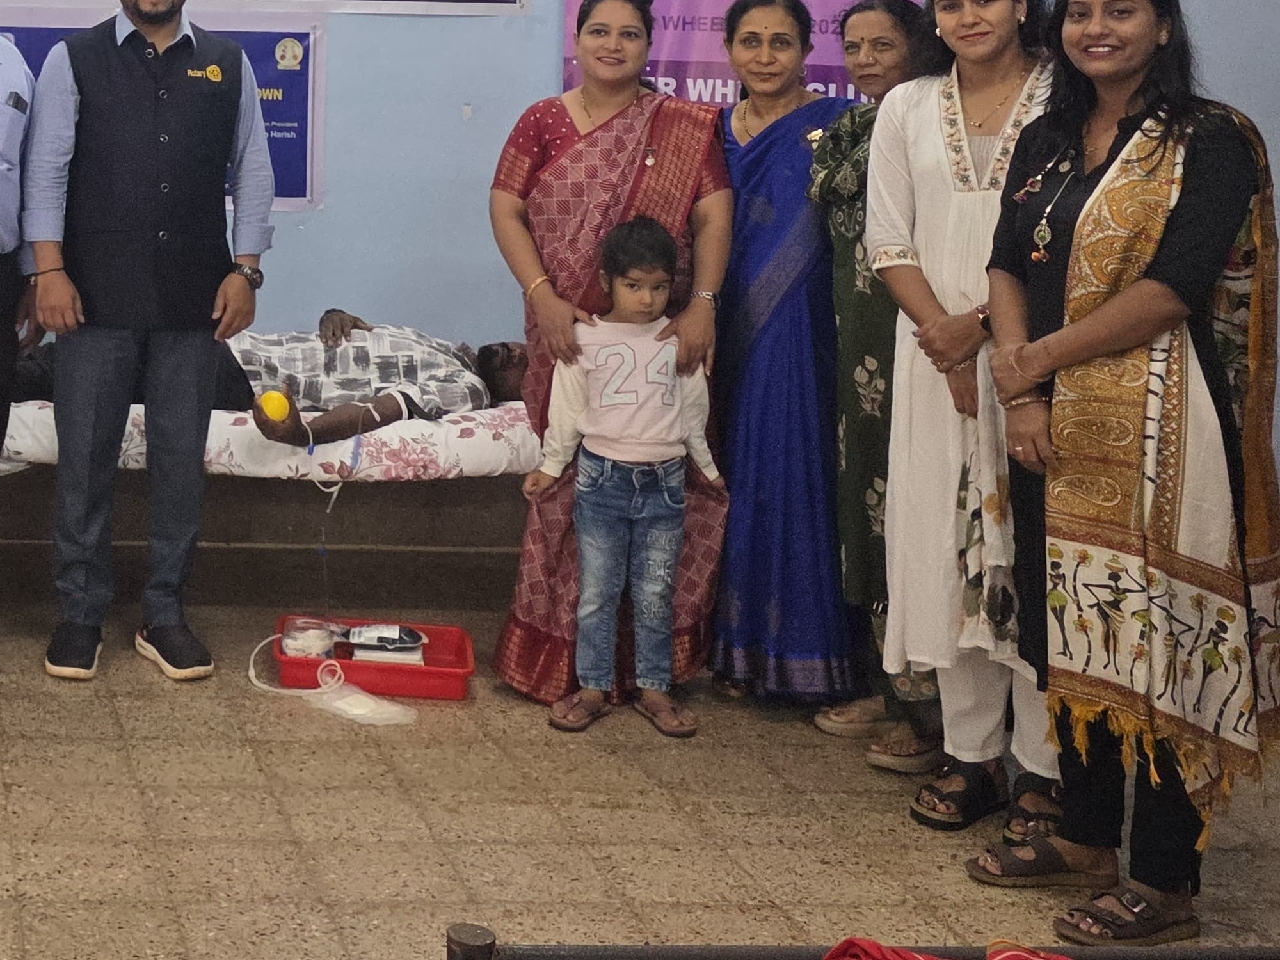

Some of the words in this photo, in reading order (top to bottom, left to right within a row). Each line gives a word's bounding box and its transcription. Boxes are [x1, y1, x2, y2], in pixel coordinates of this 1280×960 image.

[661, 15, 725, 32] WHEE
[187, 69, 206, 79] Rotary
[271, 131, 296, 139] Harish
[595, 342, 677, 408] 24
